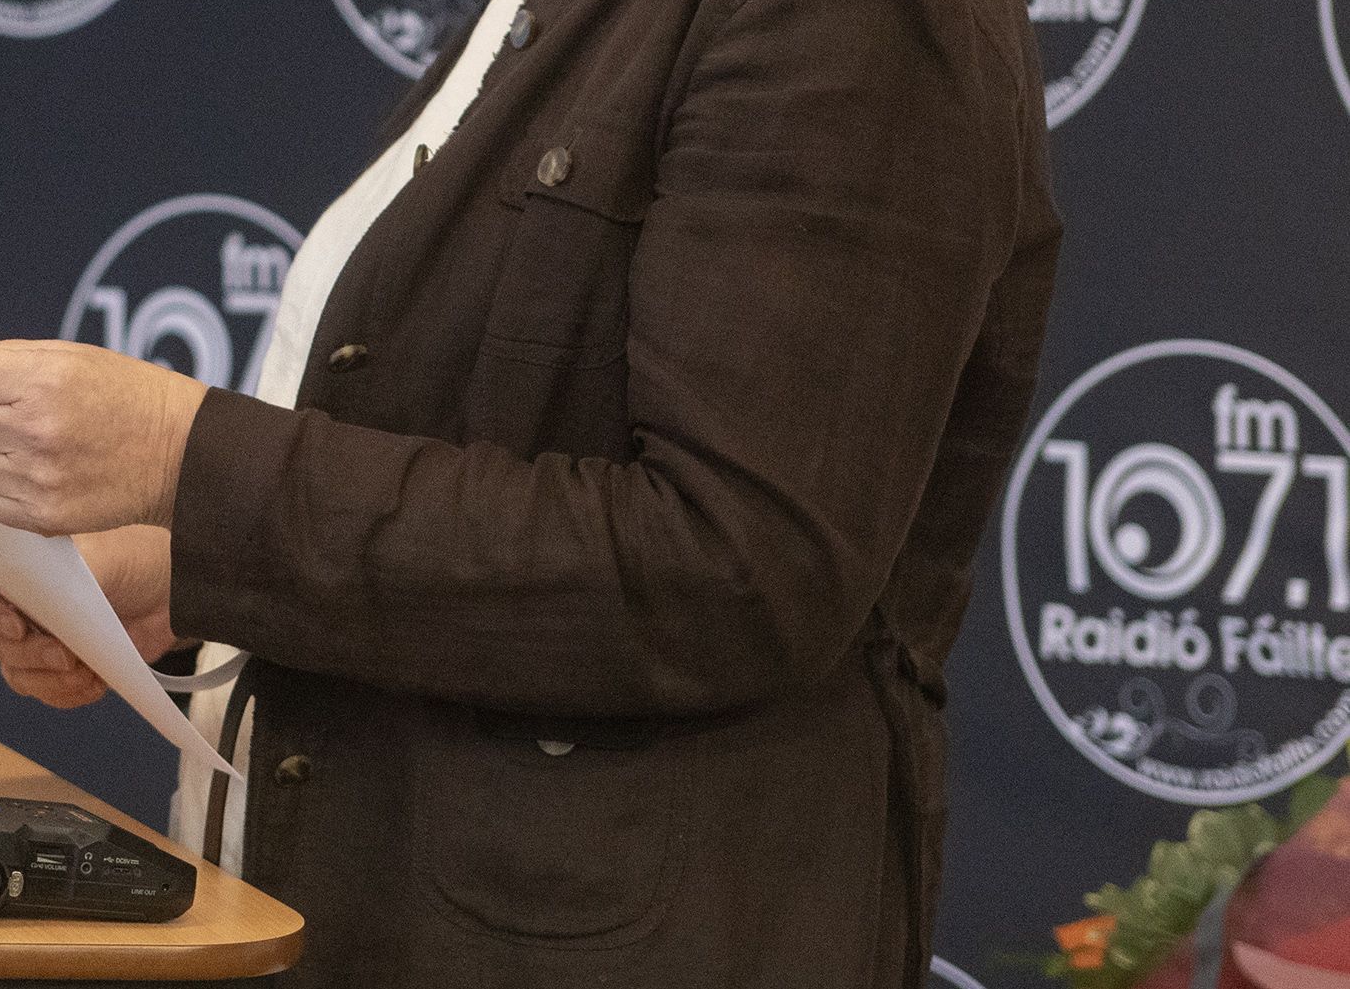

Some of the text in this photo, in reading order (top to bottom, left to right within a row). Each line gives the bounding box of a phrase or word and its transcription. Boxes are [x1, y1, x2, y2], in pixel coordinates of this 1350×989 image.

[1215, 385, 1295, 449] fm
[1045, 445, 1350, 606] 107.1
[1042, 605, 1209, 668] Raidió
